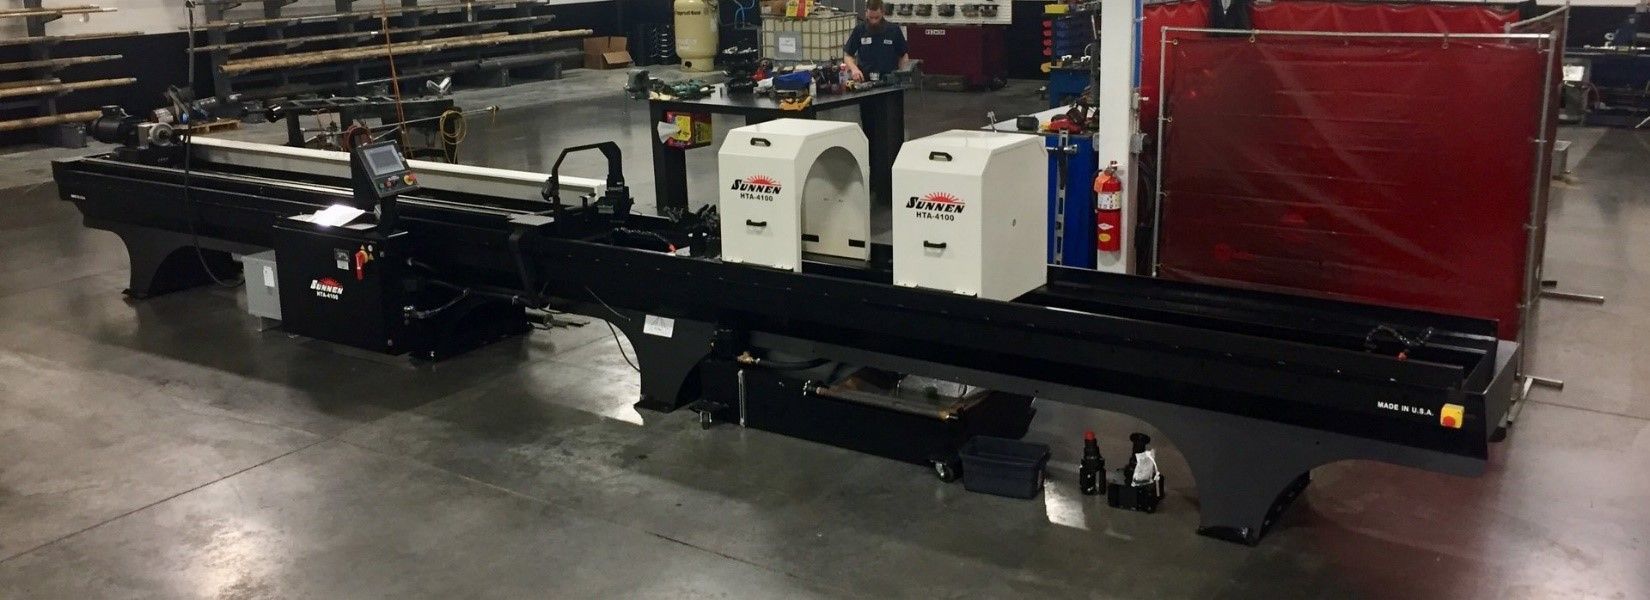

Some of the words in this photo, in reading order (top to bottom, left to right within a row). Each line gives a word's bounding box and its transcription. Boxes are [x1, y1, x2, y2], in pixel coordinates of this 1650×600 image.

[731, 179, 782, 194] SUNNEN
[740, 193, 774, 202] HTA-4100
[906, 196, 965, 213] SUNNEN
[916, 211, 955, 221] HTA-4100
[310, 279, 344, 294] SUNNEN
[1377, 401, 1399, 411] MADE
